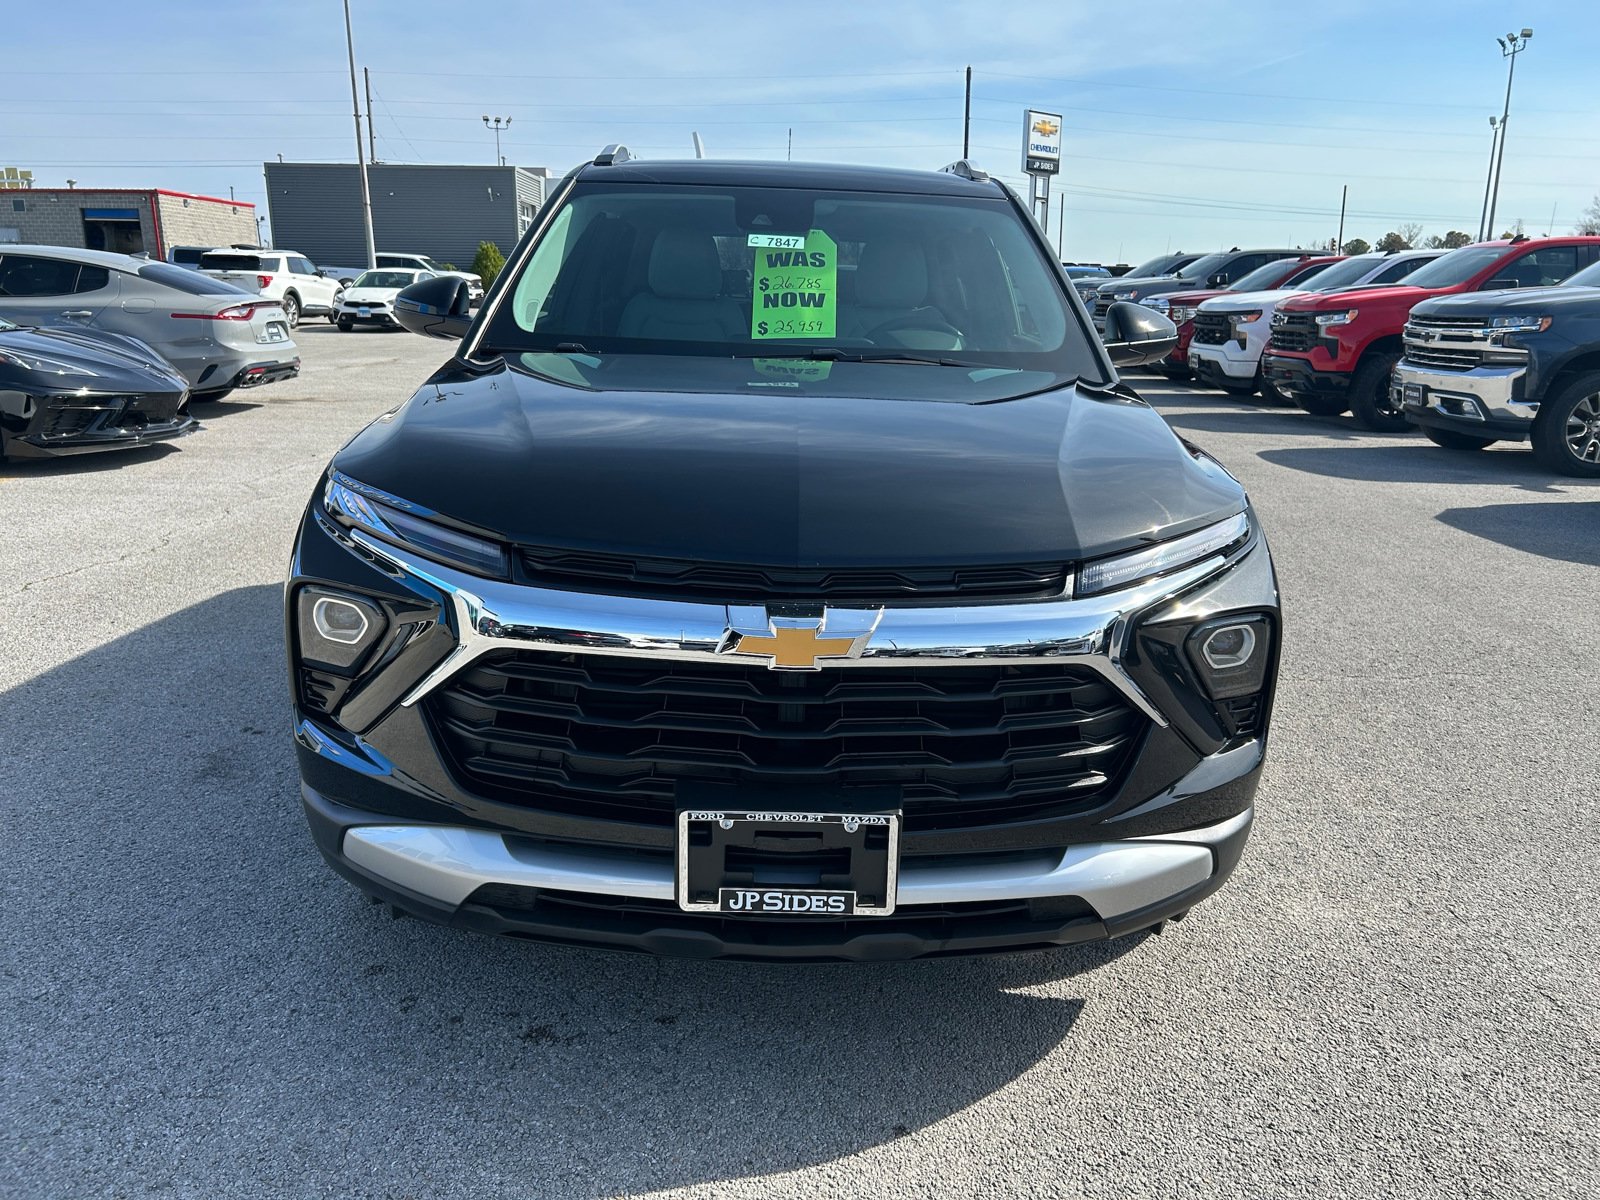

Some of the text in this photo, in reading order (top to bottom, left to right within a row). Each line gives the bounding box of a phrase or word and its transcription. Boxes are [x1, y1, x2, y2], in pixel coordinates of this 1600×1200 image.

[1030, 143, 1058, 154] CHEVROLET
[1034, 161, 1054, 170] JP SIDES
[767, 237, 800, 248] 7847
[766, 251, 826, 268] WAS
[759, 276, 770, 292] $
[763, 292, 826, 308] NOW
[757, 320, 823, 336] $ 25,959
[746, 813, 824, 822] CHEVROLET
[841, 816, 887, 824] MAZDA
[729, 891, 846, 912] JP SIDES
